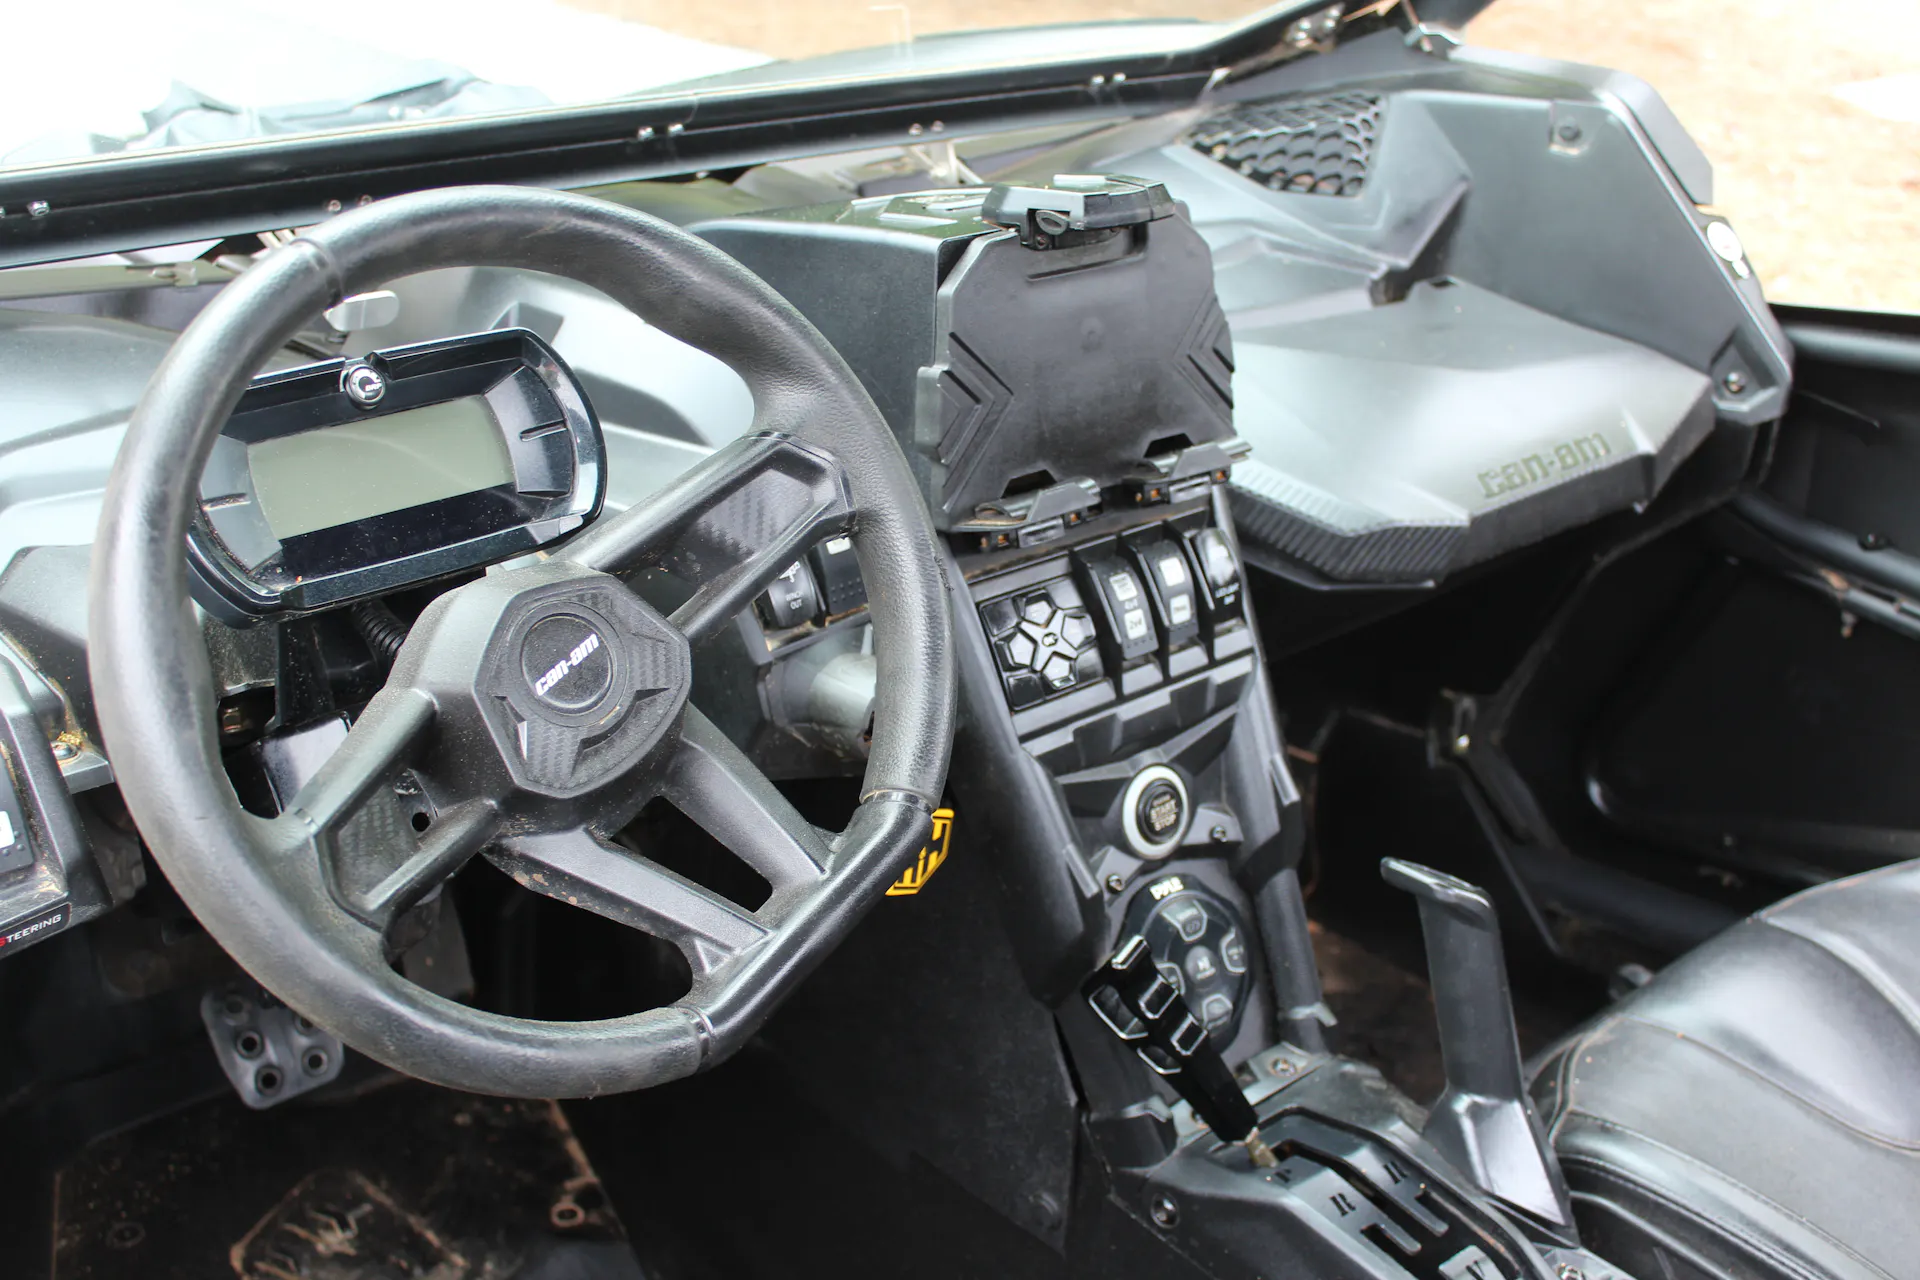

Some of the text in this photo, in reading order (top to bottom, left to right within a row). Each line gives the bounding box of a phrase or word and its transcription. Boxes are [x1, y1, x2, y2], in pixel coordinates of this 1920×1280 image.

[1476, 432, 1612, 498] can-am
[790, 599, 803, 610] OUT
[534, 633, 600, 697] can-am
